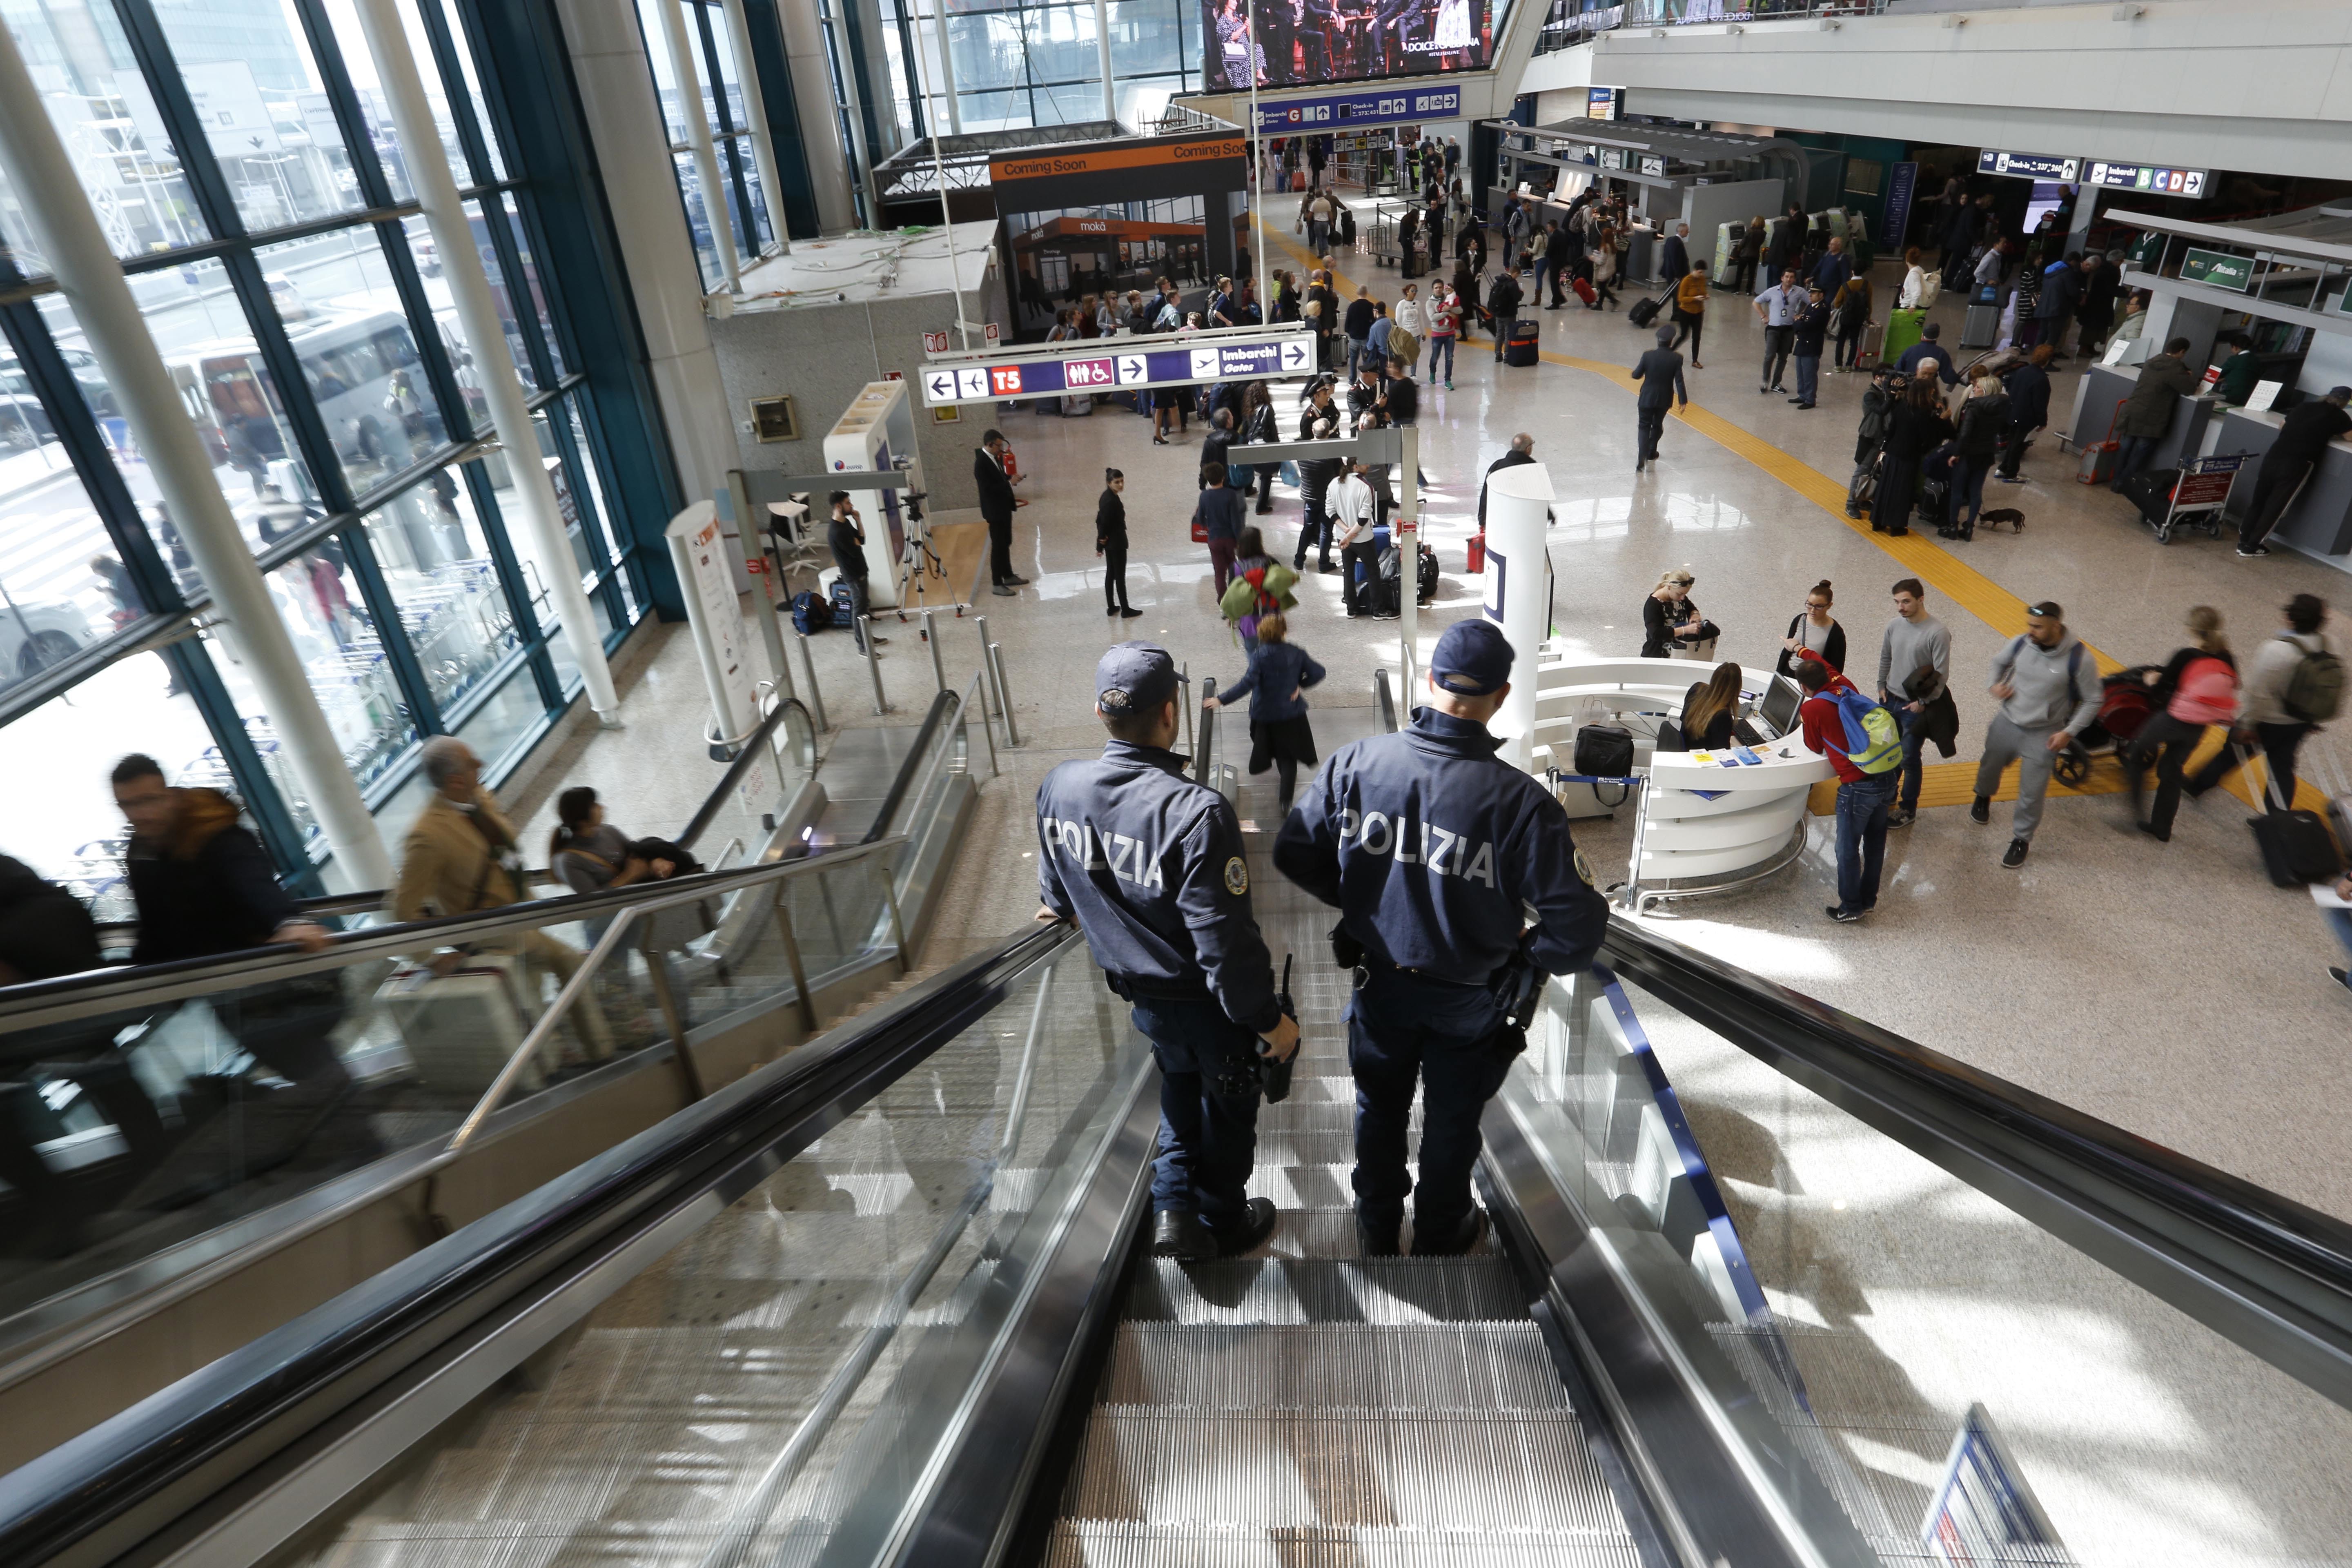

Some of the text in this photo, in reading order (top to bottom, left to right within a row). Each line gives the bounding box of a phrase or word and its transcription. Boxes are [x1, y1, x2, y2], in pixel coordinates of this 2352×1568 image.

[1290, 109, 1299, 121] G
[1305, 108, 1313, 120] H
[1174, 144, 1220, 158] Coming
[1004, 160, 1087, 175] Coming Soon
[2009, 160, 2030, 169] Check-in
[2108, 167, 2182, 190] Imbarchi B C D
[2211, 263, 2237, 276] Alitalia
[1222, 345, 1277, 361] Imbarchi
[1224, 363, 1254, 373] Gates
[993, 370, 1020, 390] T5
[1043, 817, 1169, 892] POLIZIA
[1338, 808, 1494, 889] POLIZIA
